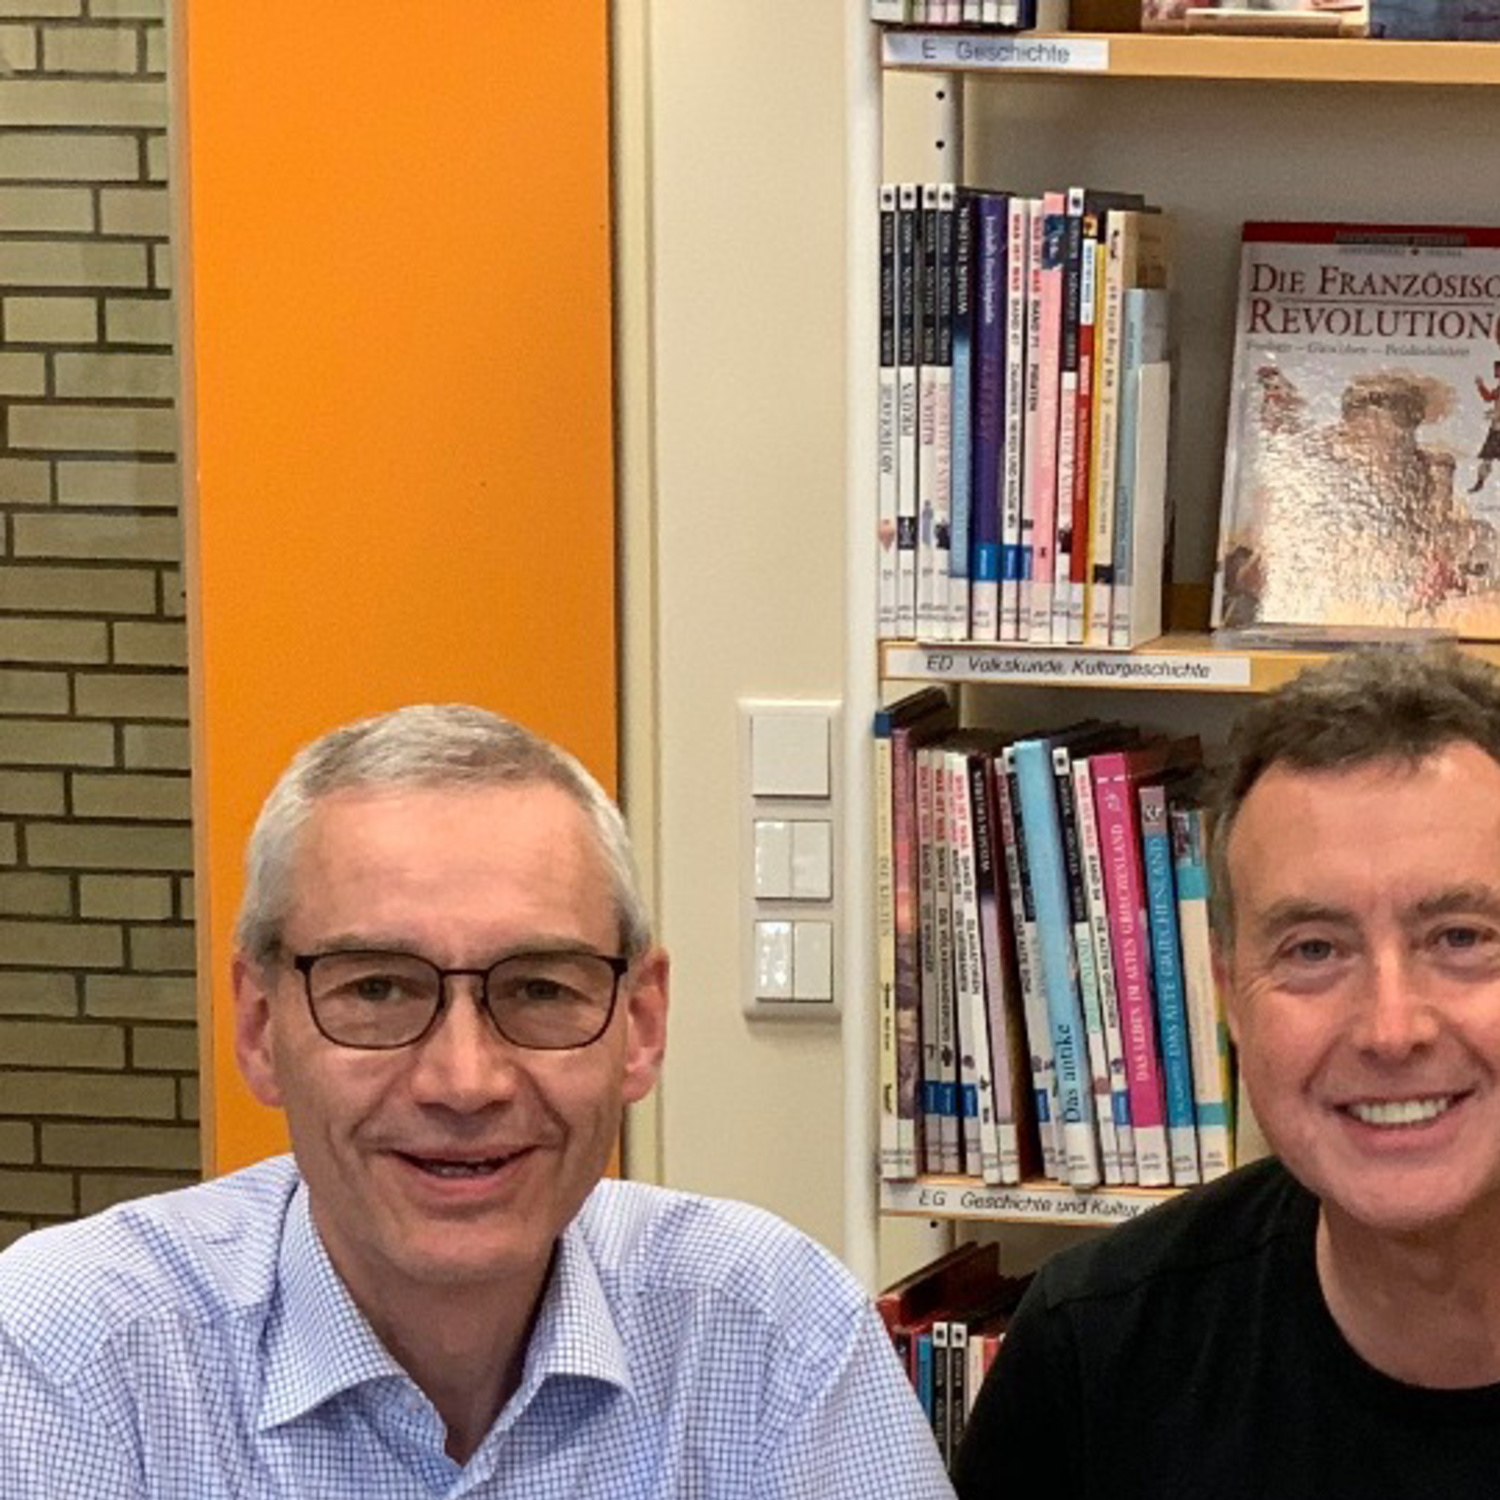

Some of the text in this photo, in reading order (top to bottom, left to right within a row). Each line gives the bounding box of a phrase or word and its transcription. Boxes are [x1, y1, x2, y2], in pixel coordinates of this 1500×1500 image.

[921, 39, 1070, 63] E Geschichte
[1251, 263, 1306, 294] DIE
[1248, 298, 1494, 341] REVOLUTION
[925, 653, 954, 672] ED
[1070, 659, 1211, 682] Kulturgeschichte
[1109, 823, 1134, 935] GRIECHENLAND
[1146, 837, 1173, 977] GRIECHENLAND
[1121, 937, 1140, 982] ALTEN
[1158, 981, 1179, 1021] ALTE
[1128, 1004, 1146, 1051] LEBEN
[1162, 1023, 1182, 1058] DAS
[1055, 1023, 1082, 1124] Das antike
[1132, 1053, 1149, 1082] DAS
[959, 1190, 1052, 1213] Geschichte
[1057, 1196, 1088, 1215] und
[1090, 1198, 1140, 1218] Kultur
